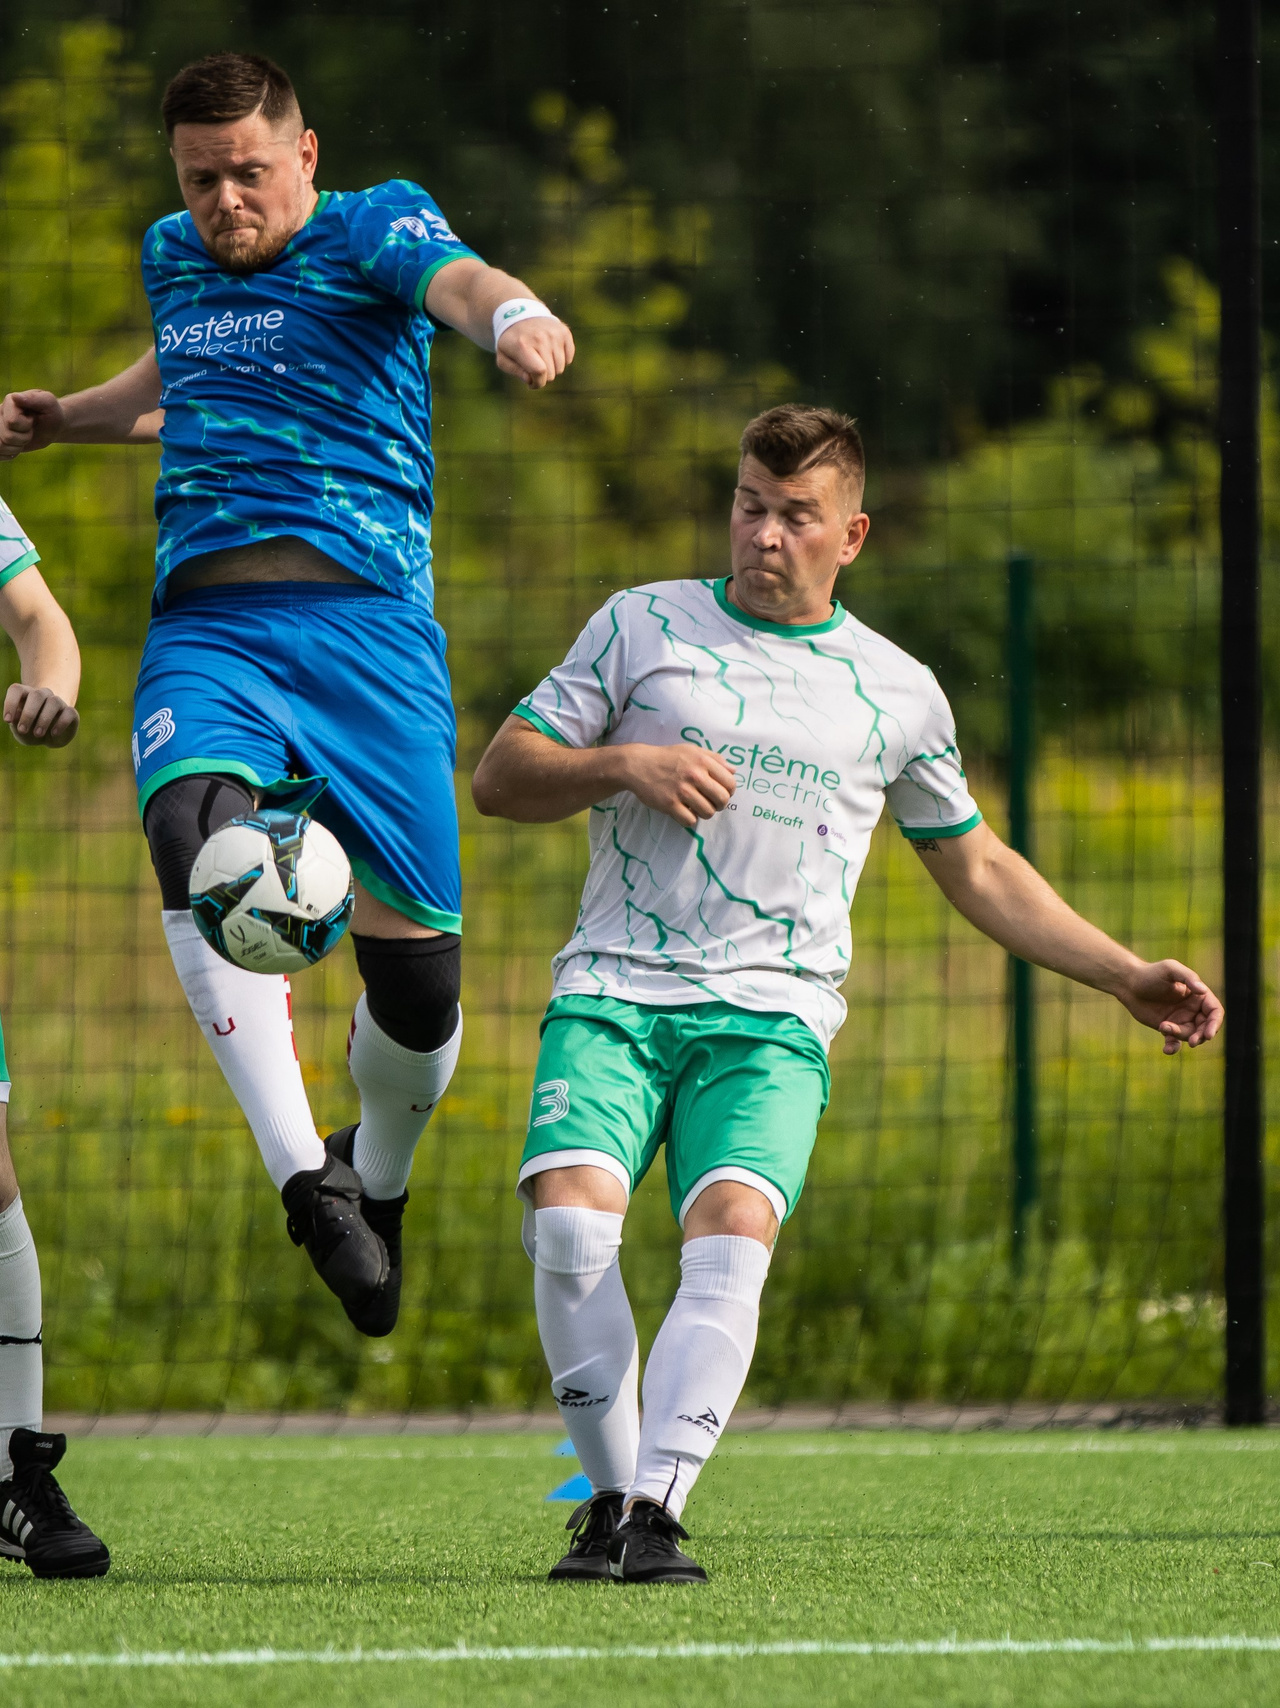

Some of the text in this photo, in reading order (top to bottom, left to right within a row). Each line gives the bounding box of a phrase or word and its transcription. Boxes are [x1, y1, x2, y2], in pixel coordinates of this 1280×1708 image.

[159, 309, 285, 354] Systême
[185, 332, 285, 358] electric
[752, 805, 804, 829] Dēkraft
[527, 1079, 570, 1133] 3
[676, 1414, 719, 1441] DEMI
